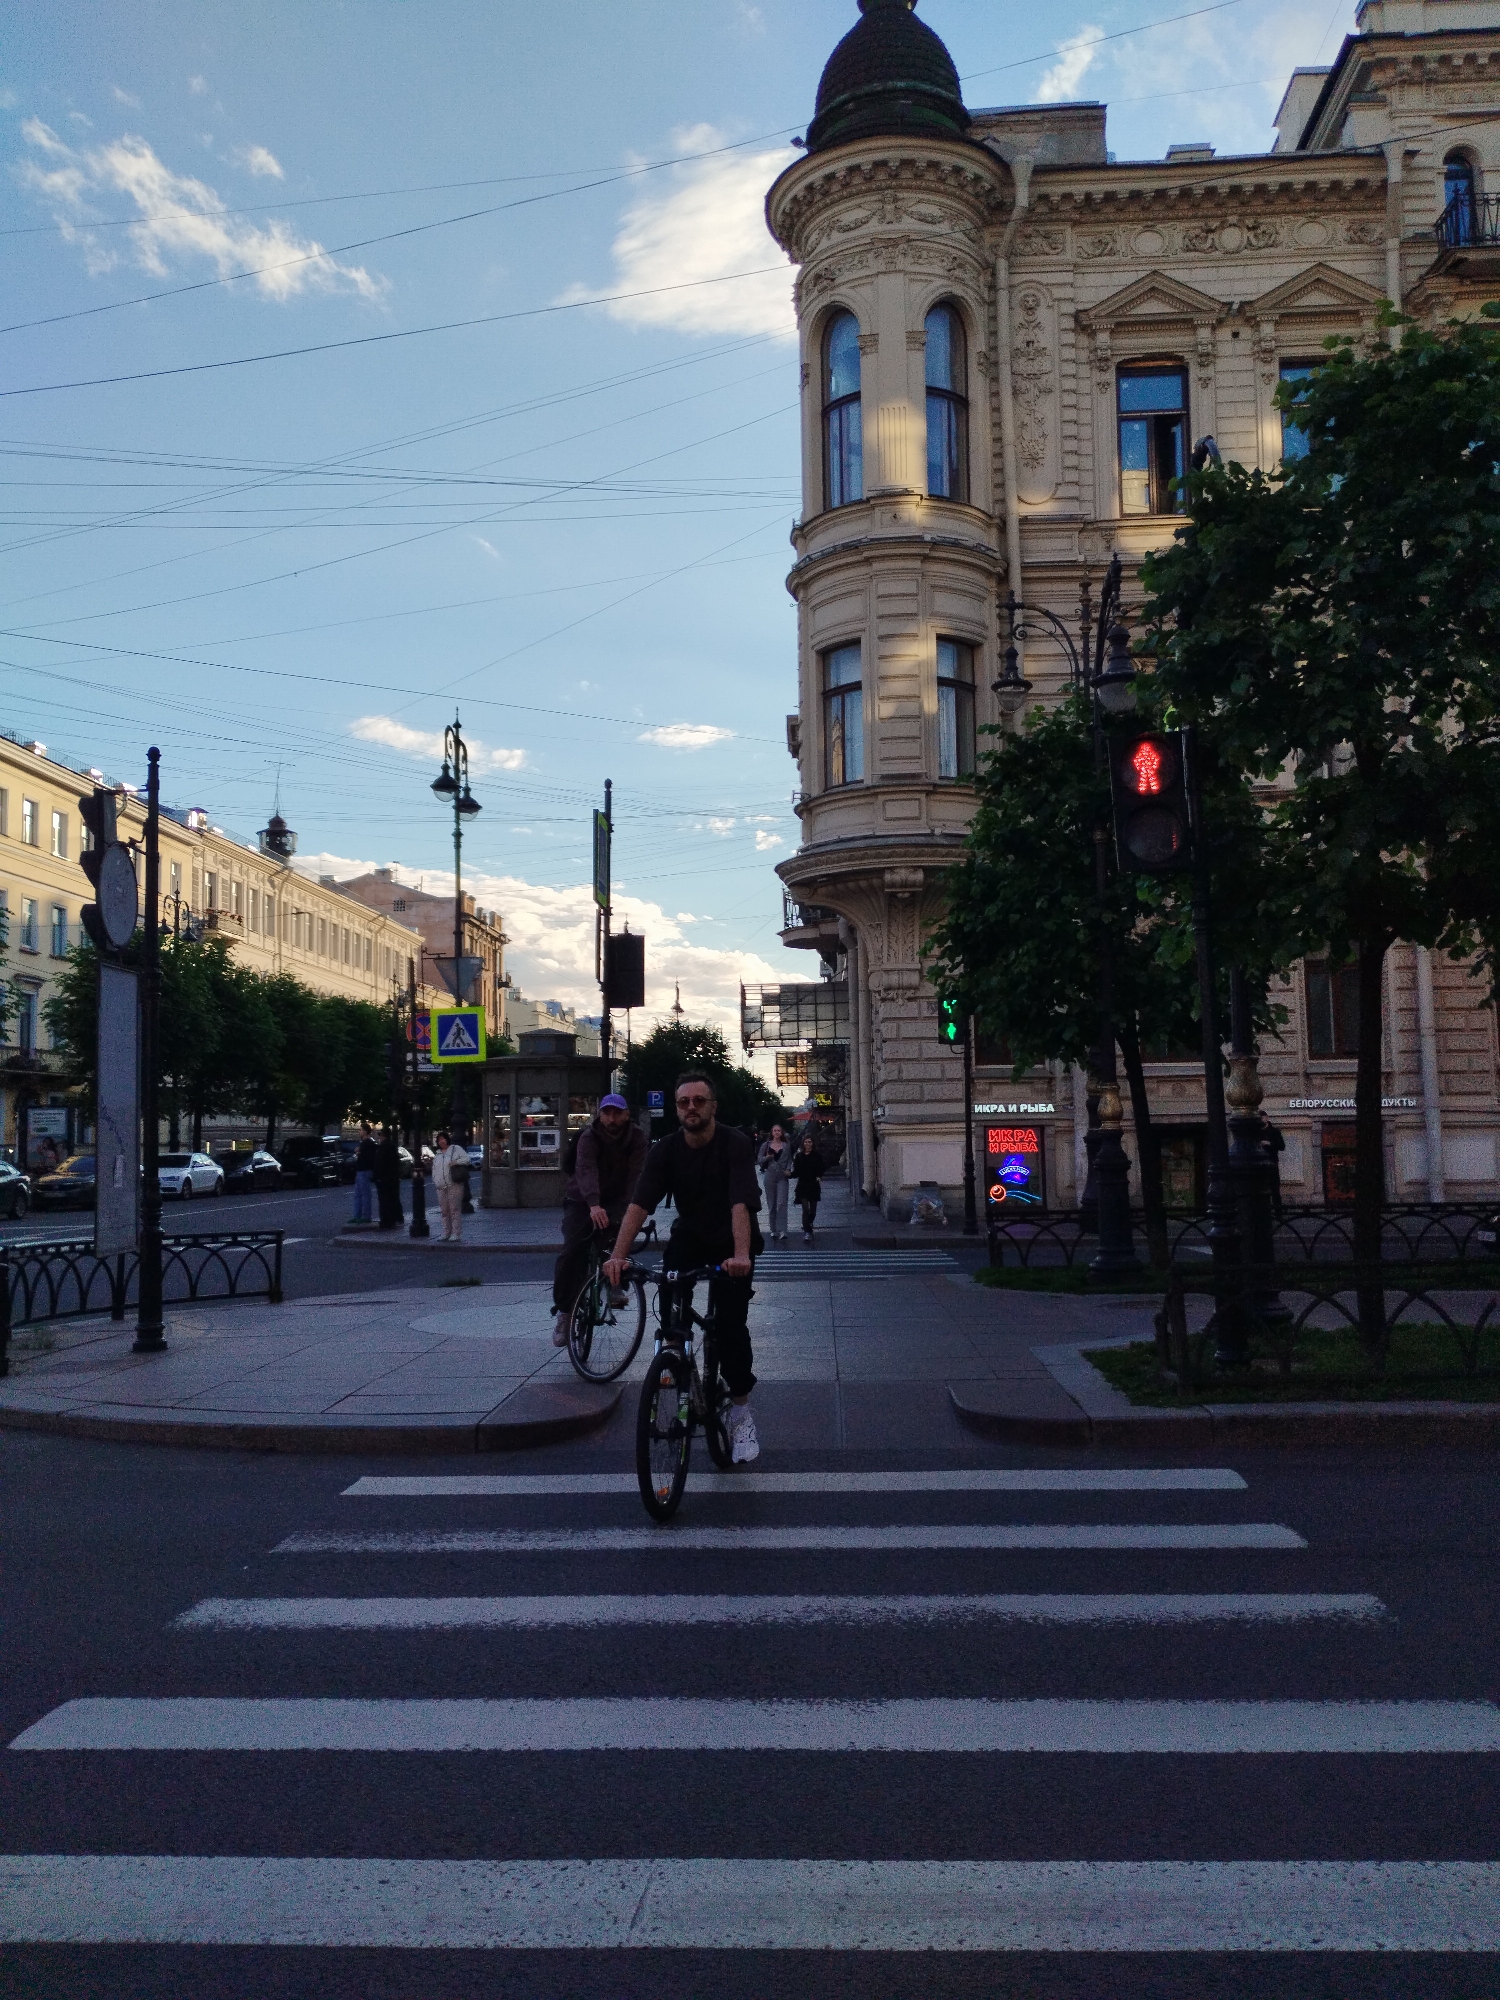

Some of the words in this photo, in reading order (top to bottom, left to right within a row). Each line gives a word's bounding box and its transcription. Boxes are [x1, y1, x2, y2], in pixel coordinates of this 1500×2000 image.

[974, 1104, 1006, 1113] ИКРА
[1008, 1104, 1017, 1112] И
[1020, 1103, 1055, 1113] РЫБА
[1289, 1099, 1357, 1108] БЕЛОРУССКИ
[988, 1129, 1037, 1142] ИКРА
[989, 1142, 999, 1153] И
[1000, 1142, 1039, 1153] РЫБА
